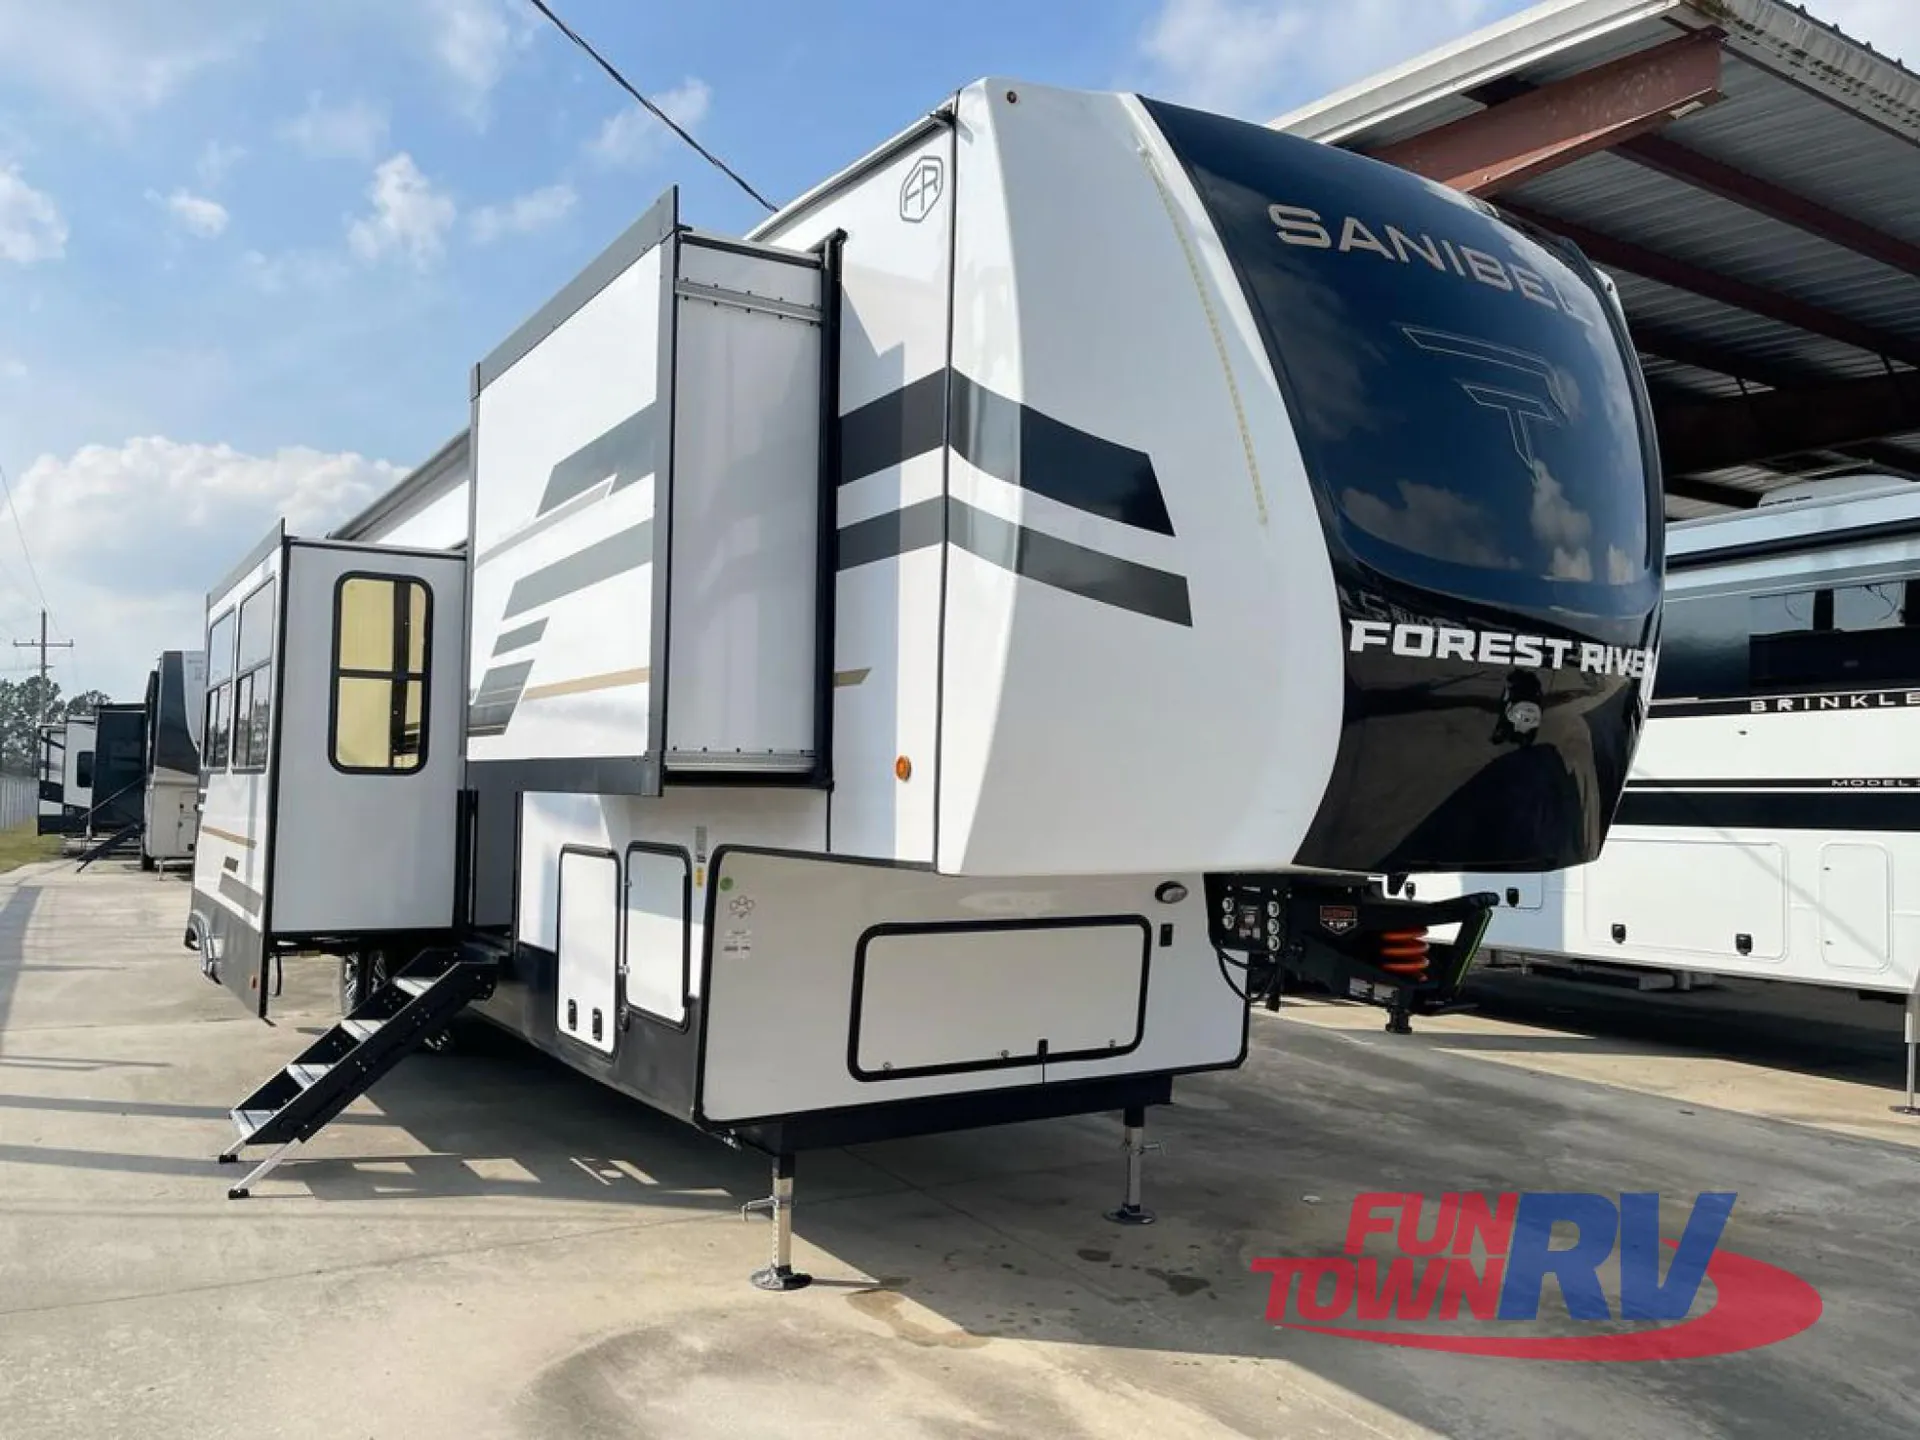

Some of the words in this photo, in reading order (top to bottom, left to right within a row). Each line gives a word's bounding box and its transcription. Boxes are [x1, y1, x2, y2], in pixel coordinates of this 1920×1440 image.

[1267, 203, 1594, 327] SANIBEL
[1348, 619, 1574, 670] FOREST
[1750, 692, 1920, 712] BRINKLE
[1831, 779, 1909, 787] MODEL
